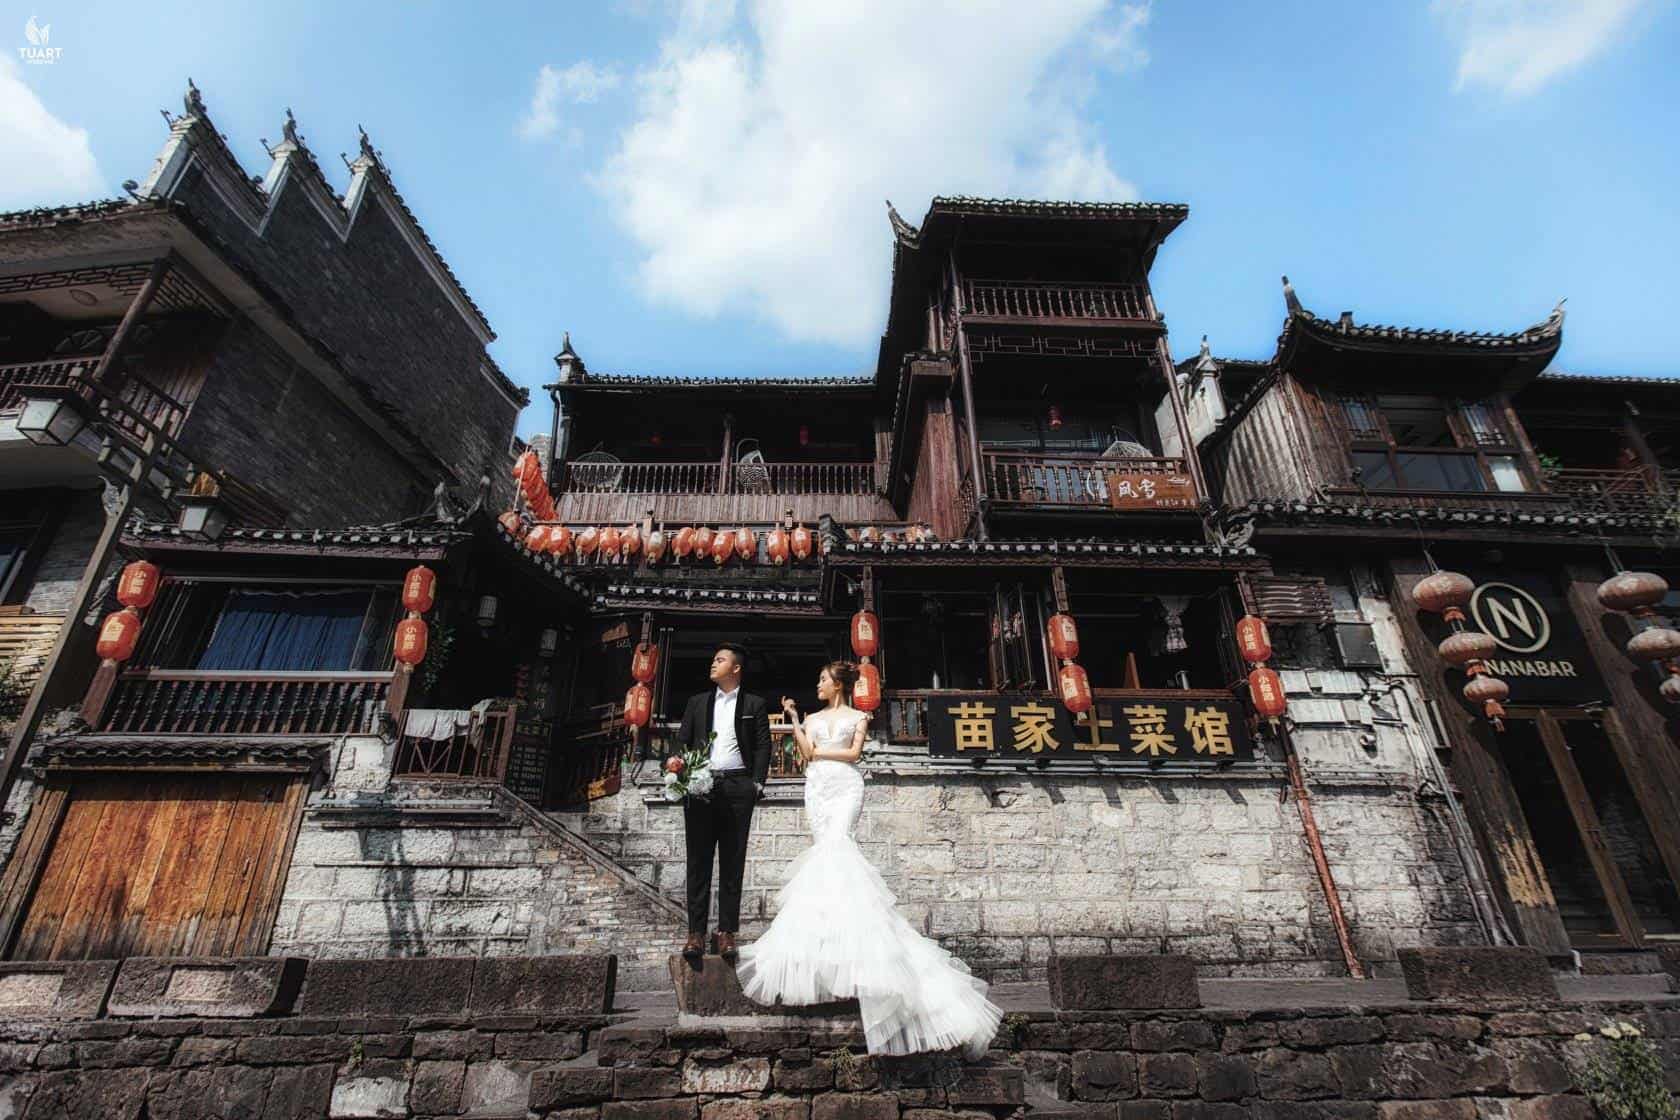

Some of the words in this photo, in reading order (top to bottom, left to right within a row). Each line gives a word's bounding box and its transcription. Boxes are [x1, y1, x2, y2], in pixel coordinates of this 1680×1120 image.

[1486, 597, 1537, 639] N
[1483, 659, 1577, 677] NANABAR
[948, 702, 1235, 756] 苗家土菜馆
